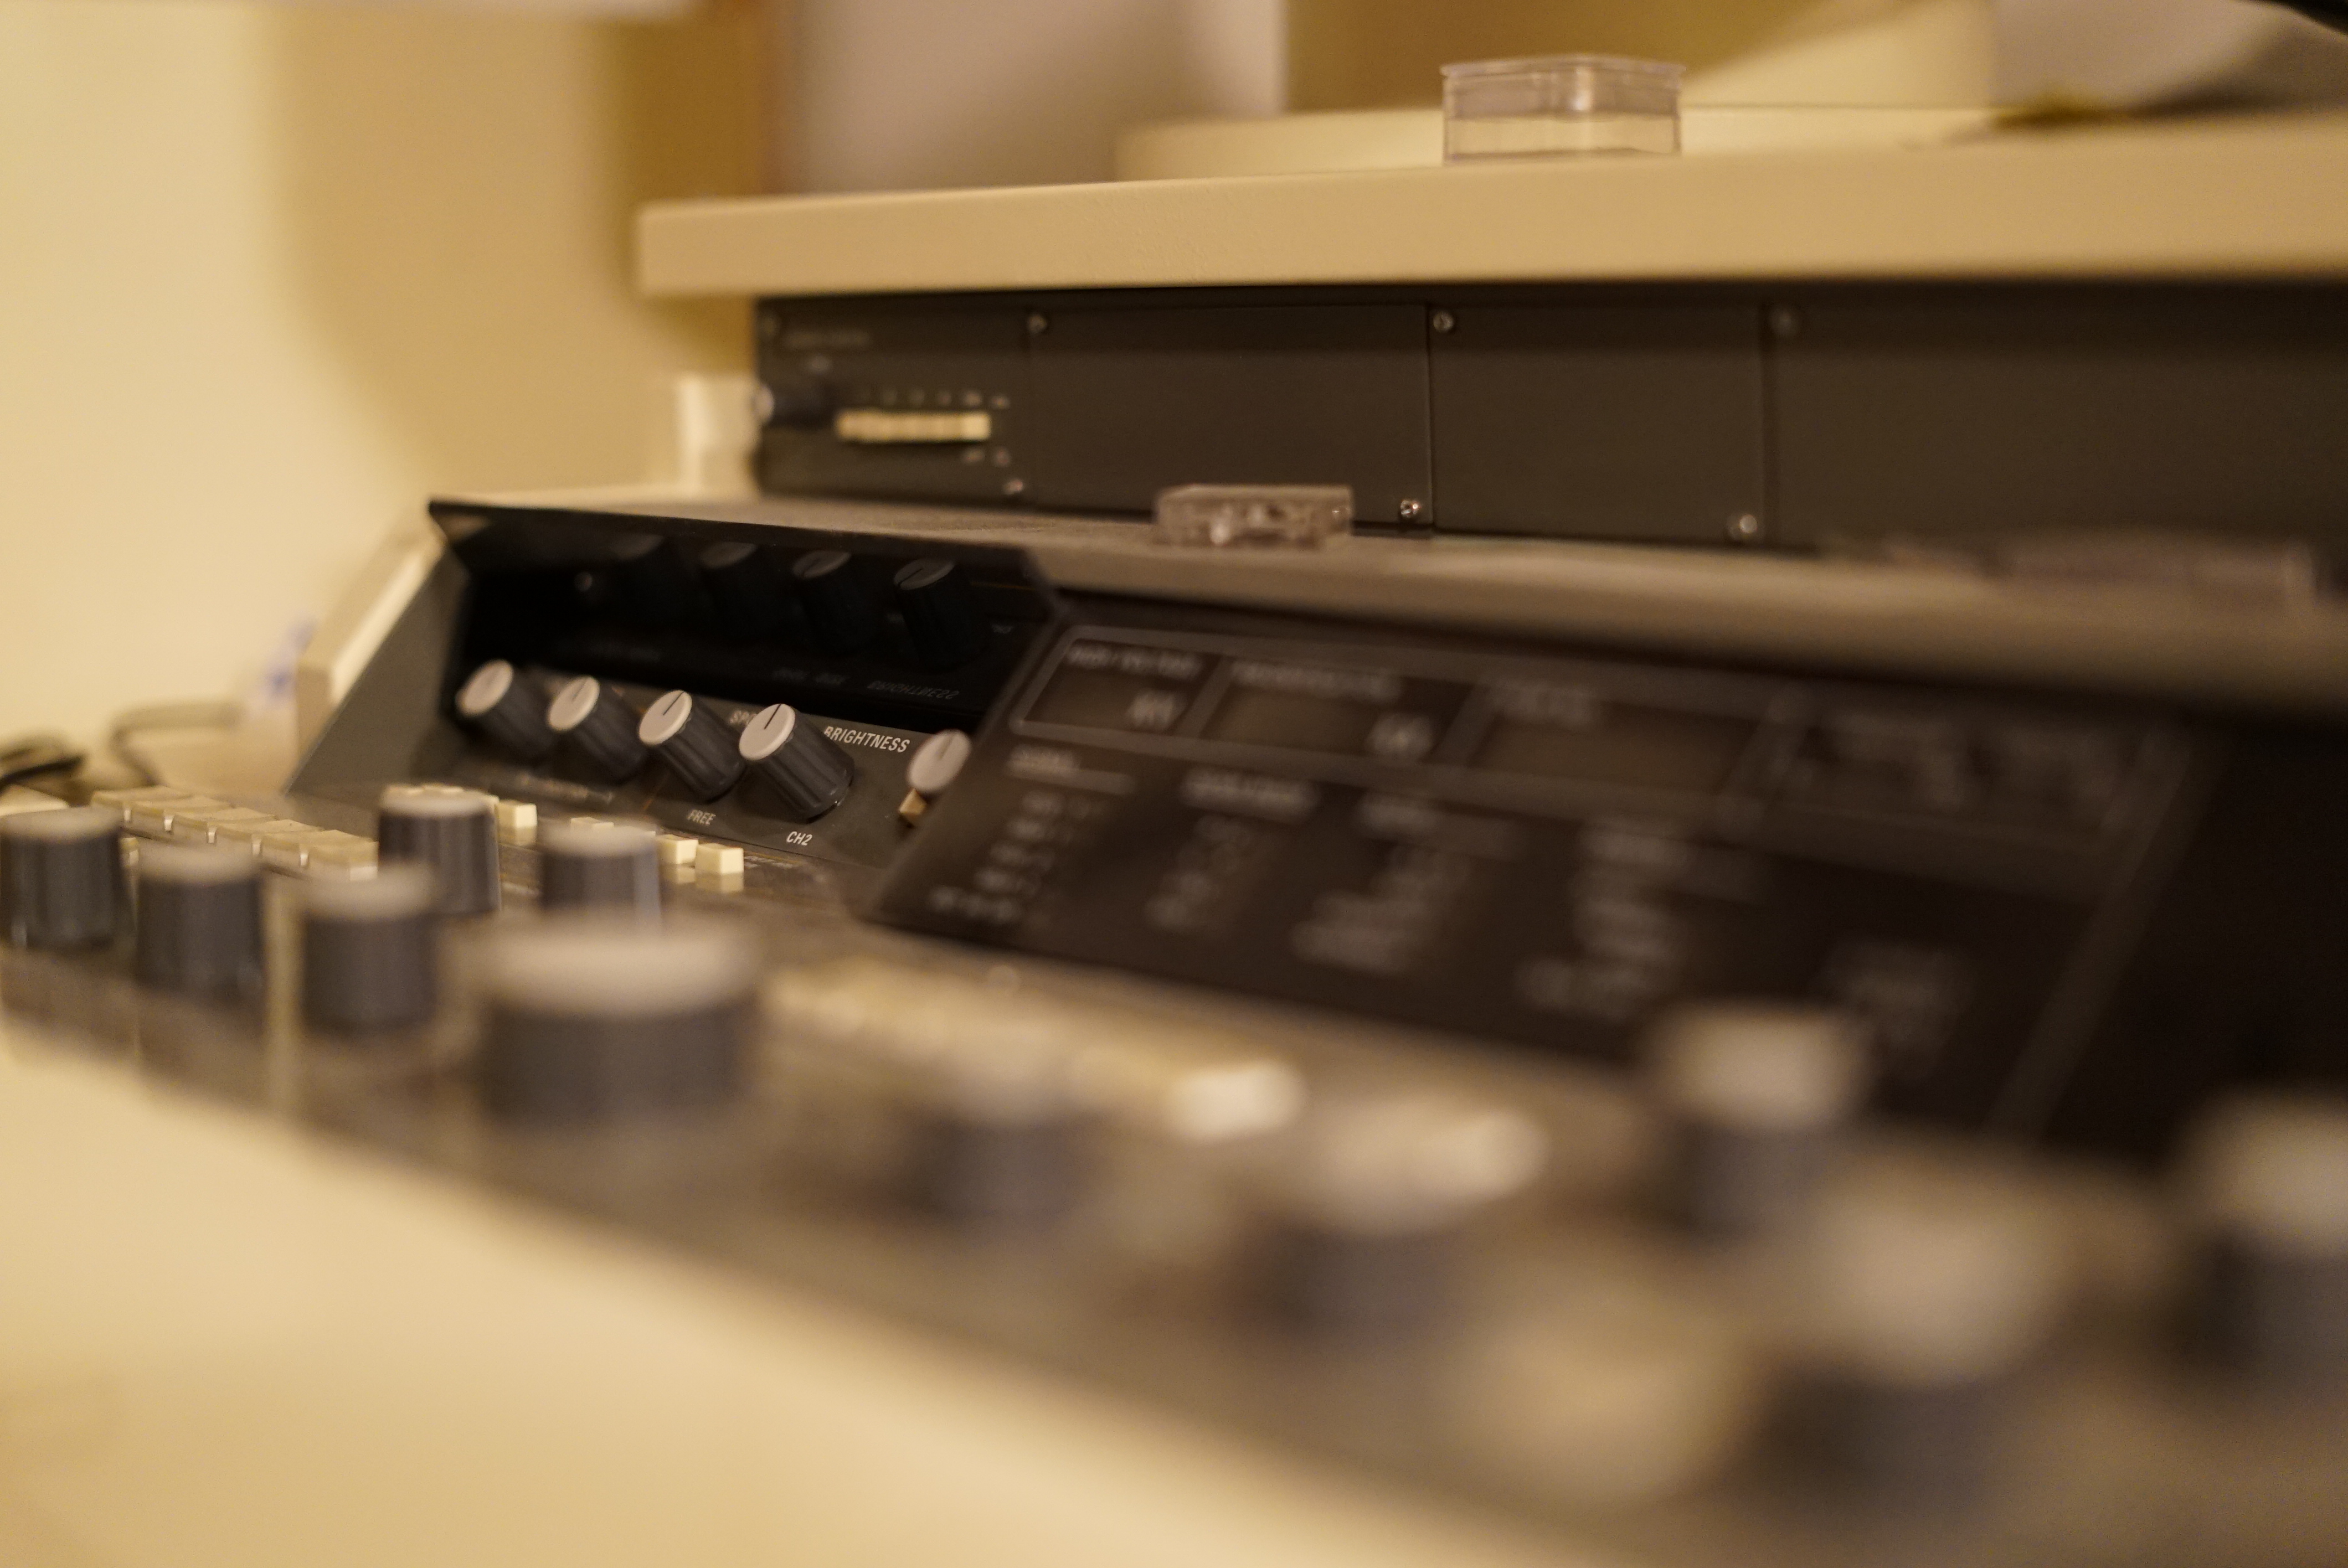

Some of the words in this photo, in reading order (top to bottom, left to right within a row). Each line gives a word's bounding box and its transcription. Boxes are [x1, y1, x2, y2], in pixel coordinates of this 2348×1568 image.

[823, 725, 910, 753] BRIGHTNESS
[686, 809, 717, 826] FREE
[785, 831, 813, 846] CH2
